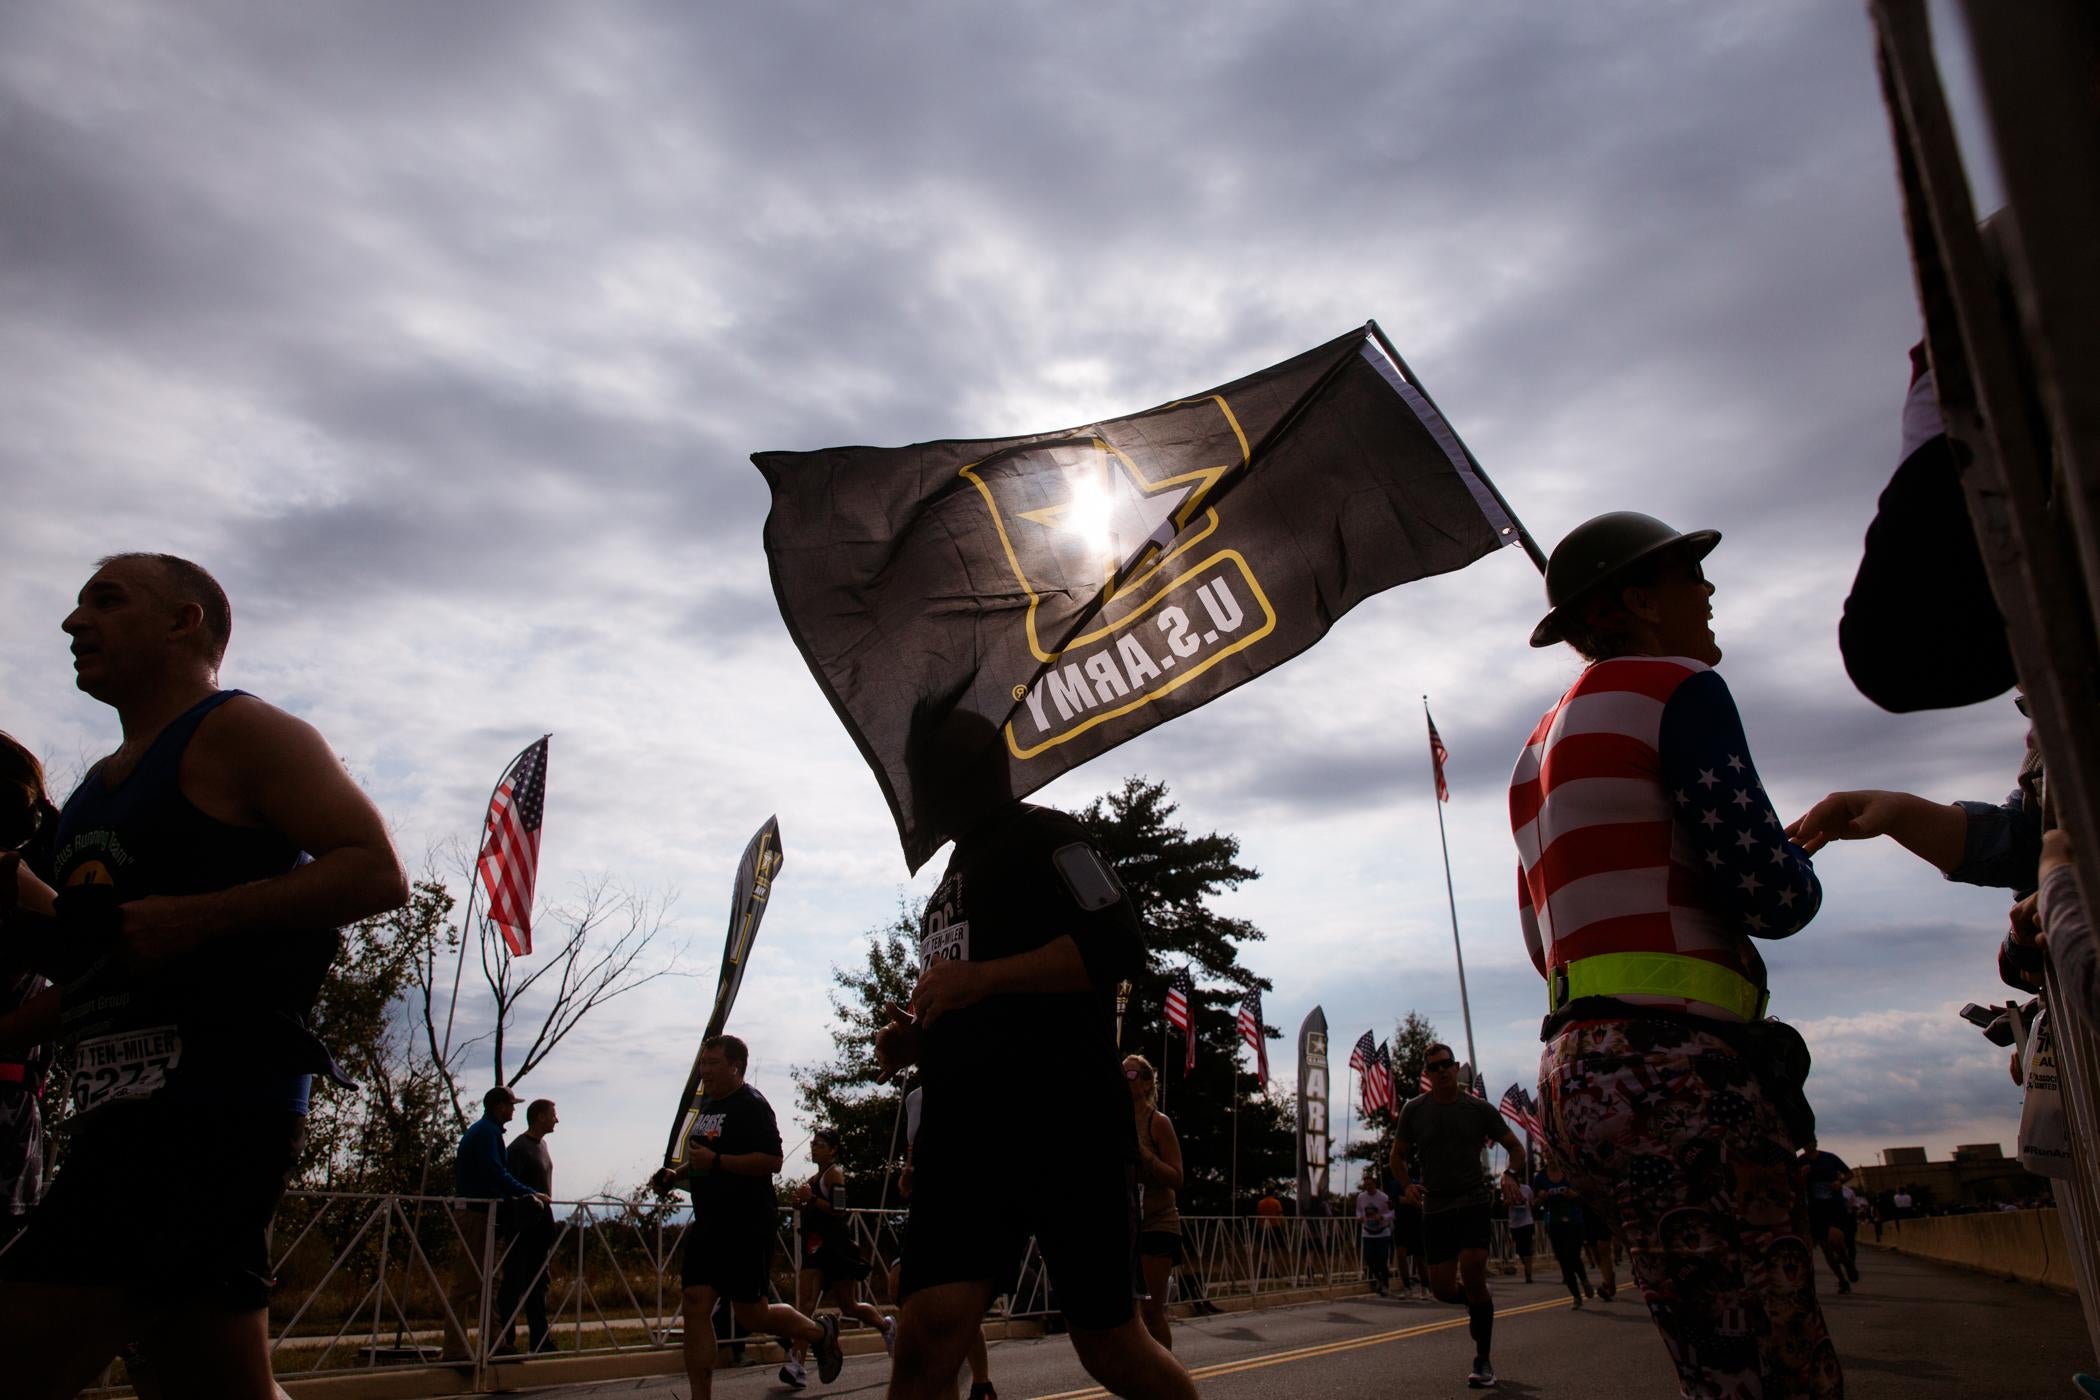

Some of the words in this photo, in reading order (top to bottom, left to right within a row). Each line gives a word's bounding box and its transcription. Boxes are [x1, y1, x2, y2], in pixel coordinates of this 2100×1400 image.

[931, 926, 964, 951] TEN-MILER
[89, 1031, 176, 1066] TEN-MILER
[1305, 1067, 1327, 1198] ARMY
